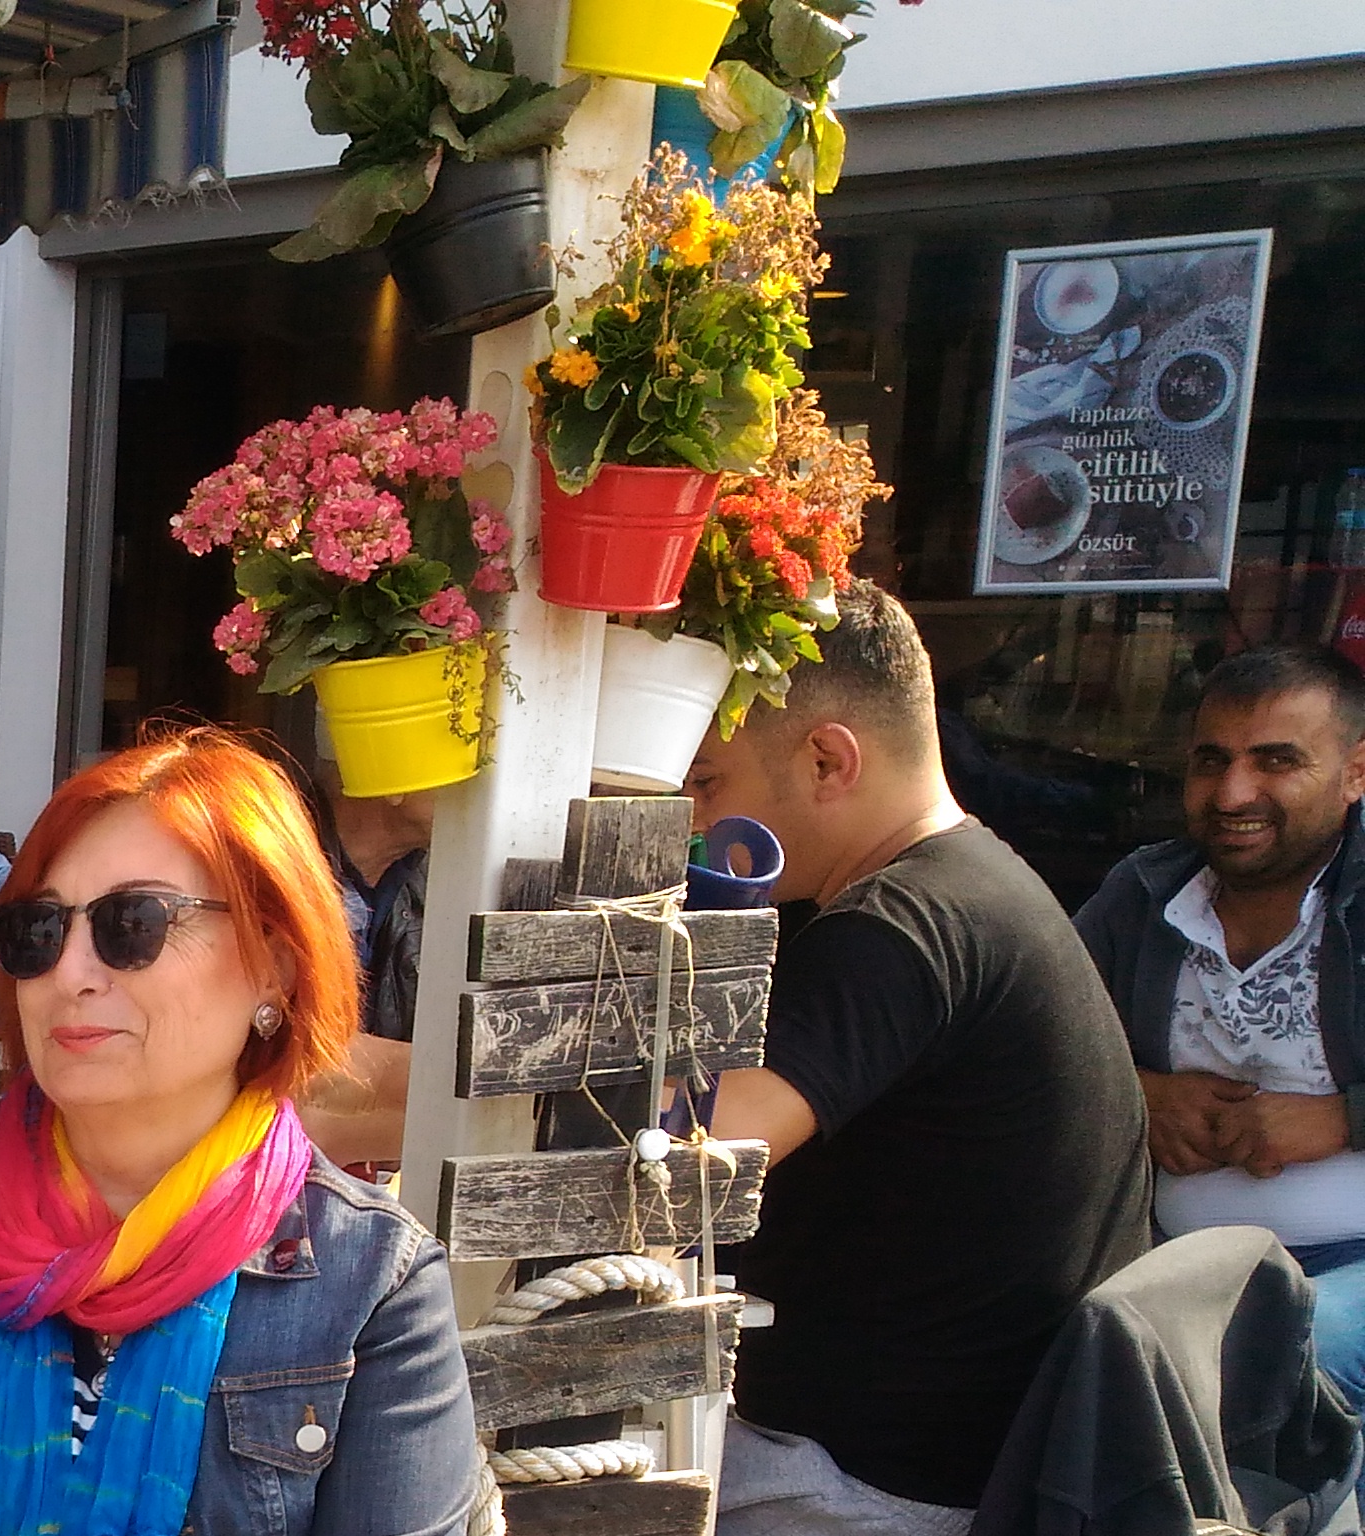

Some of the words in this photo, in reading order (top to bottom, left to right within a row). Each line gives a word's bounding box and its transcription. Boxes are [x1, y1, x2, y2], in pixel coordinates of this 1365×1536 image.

[1062, 429, 1137, 453] günlük
[1090, 476, 1203, 508] sütüyle
[1078, 534, 1137, 552] ÖZSÜT
